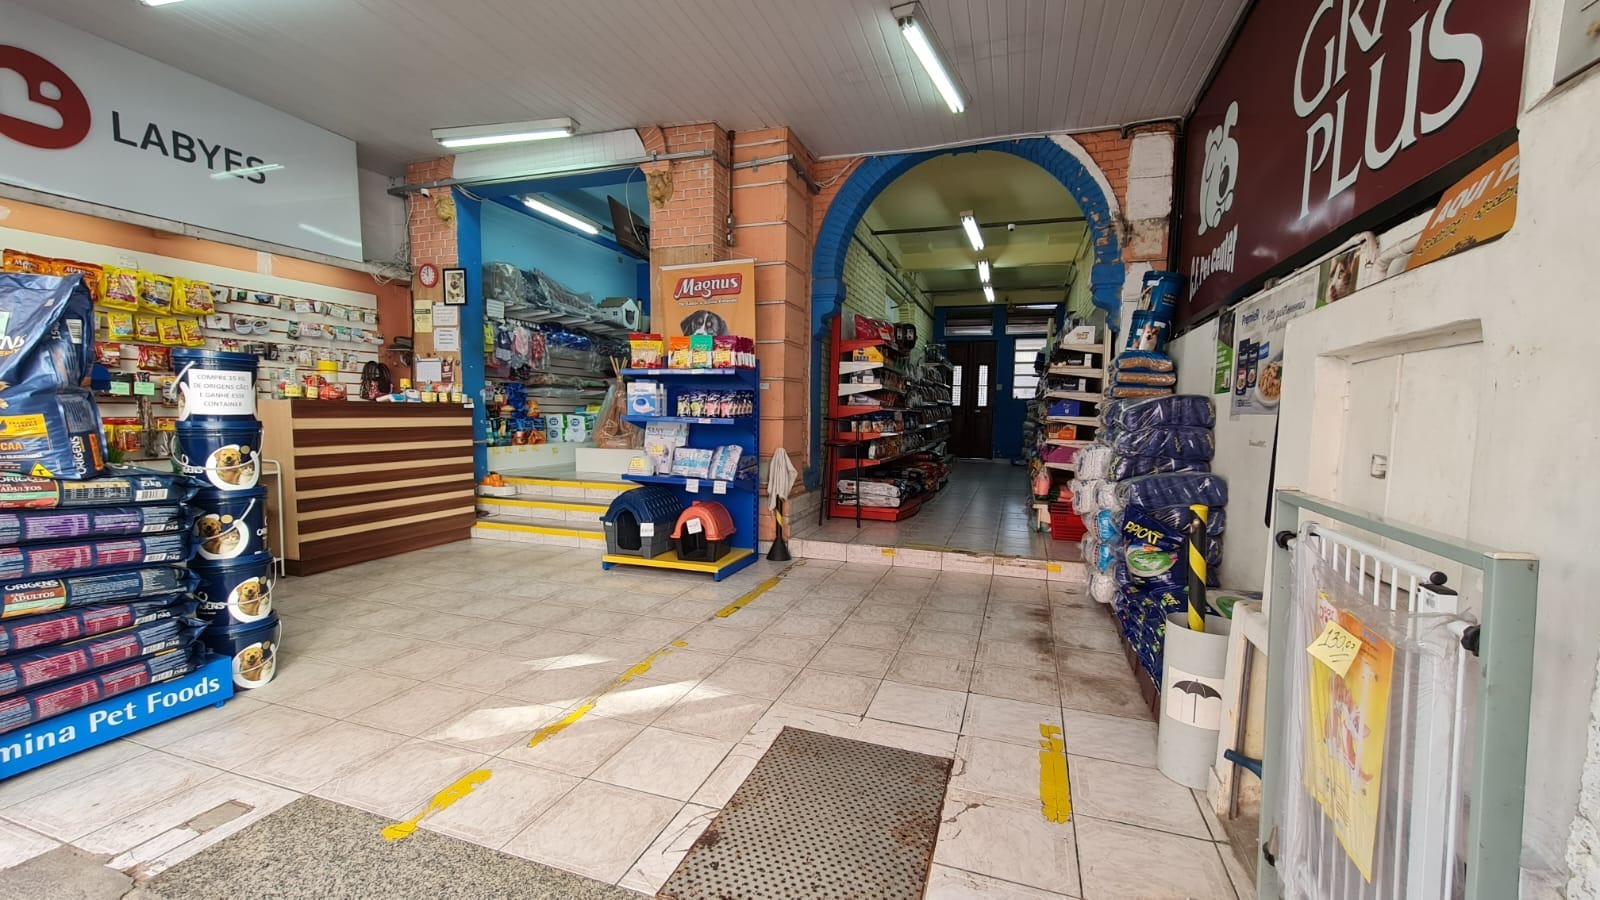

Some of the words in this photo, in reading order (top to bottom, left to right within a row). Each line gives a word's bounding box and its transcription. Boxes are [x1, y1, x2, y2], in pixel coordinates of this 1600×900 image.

[1300, 0, 1483, 220] PLUS
[111, 110, 267, 184] LABYES
[674, 277, 739, 298] Magnus
[70, 435, 87, 475] ORIGENS
[4, 579, 59, 592] ORIGENS
[12, 591, 56, 603] ADULTOS
[89, 701, 137, 733] Pet
[147, 676, 221, 714] Foods
